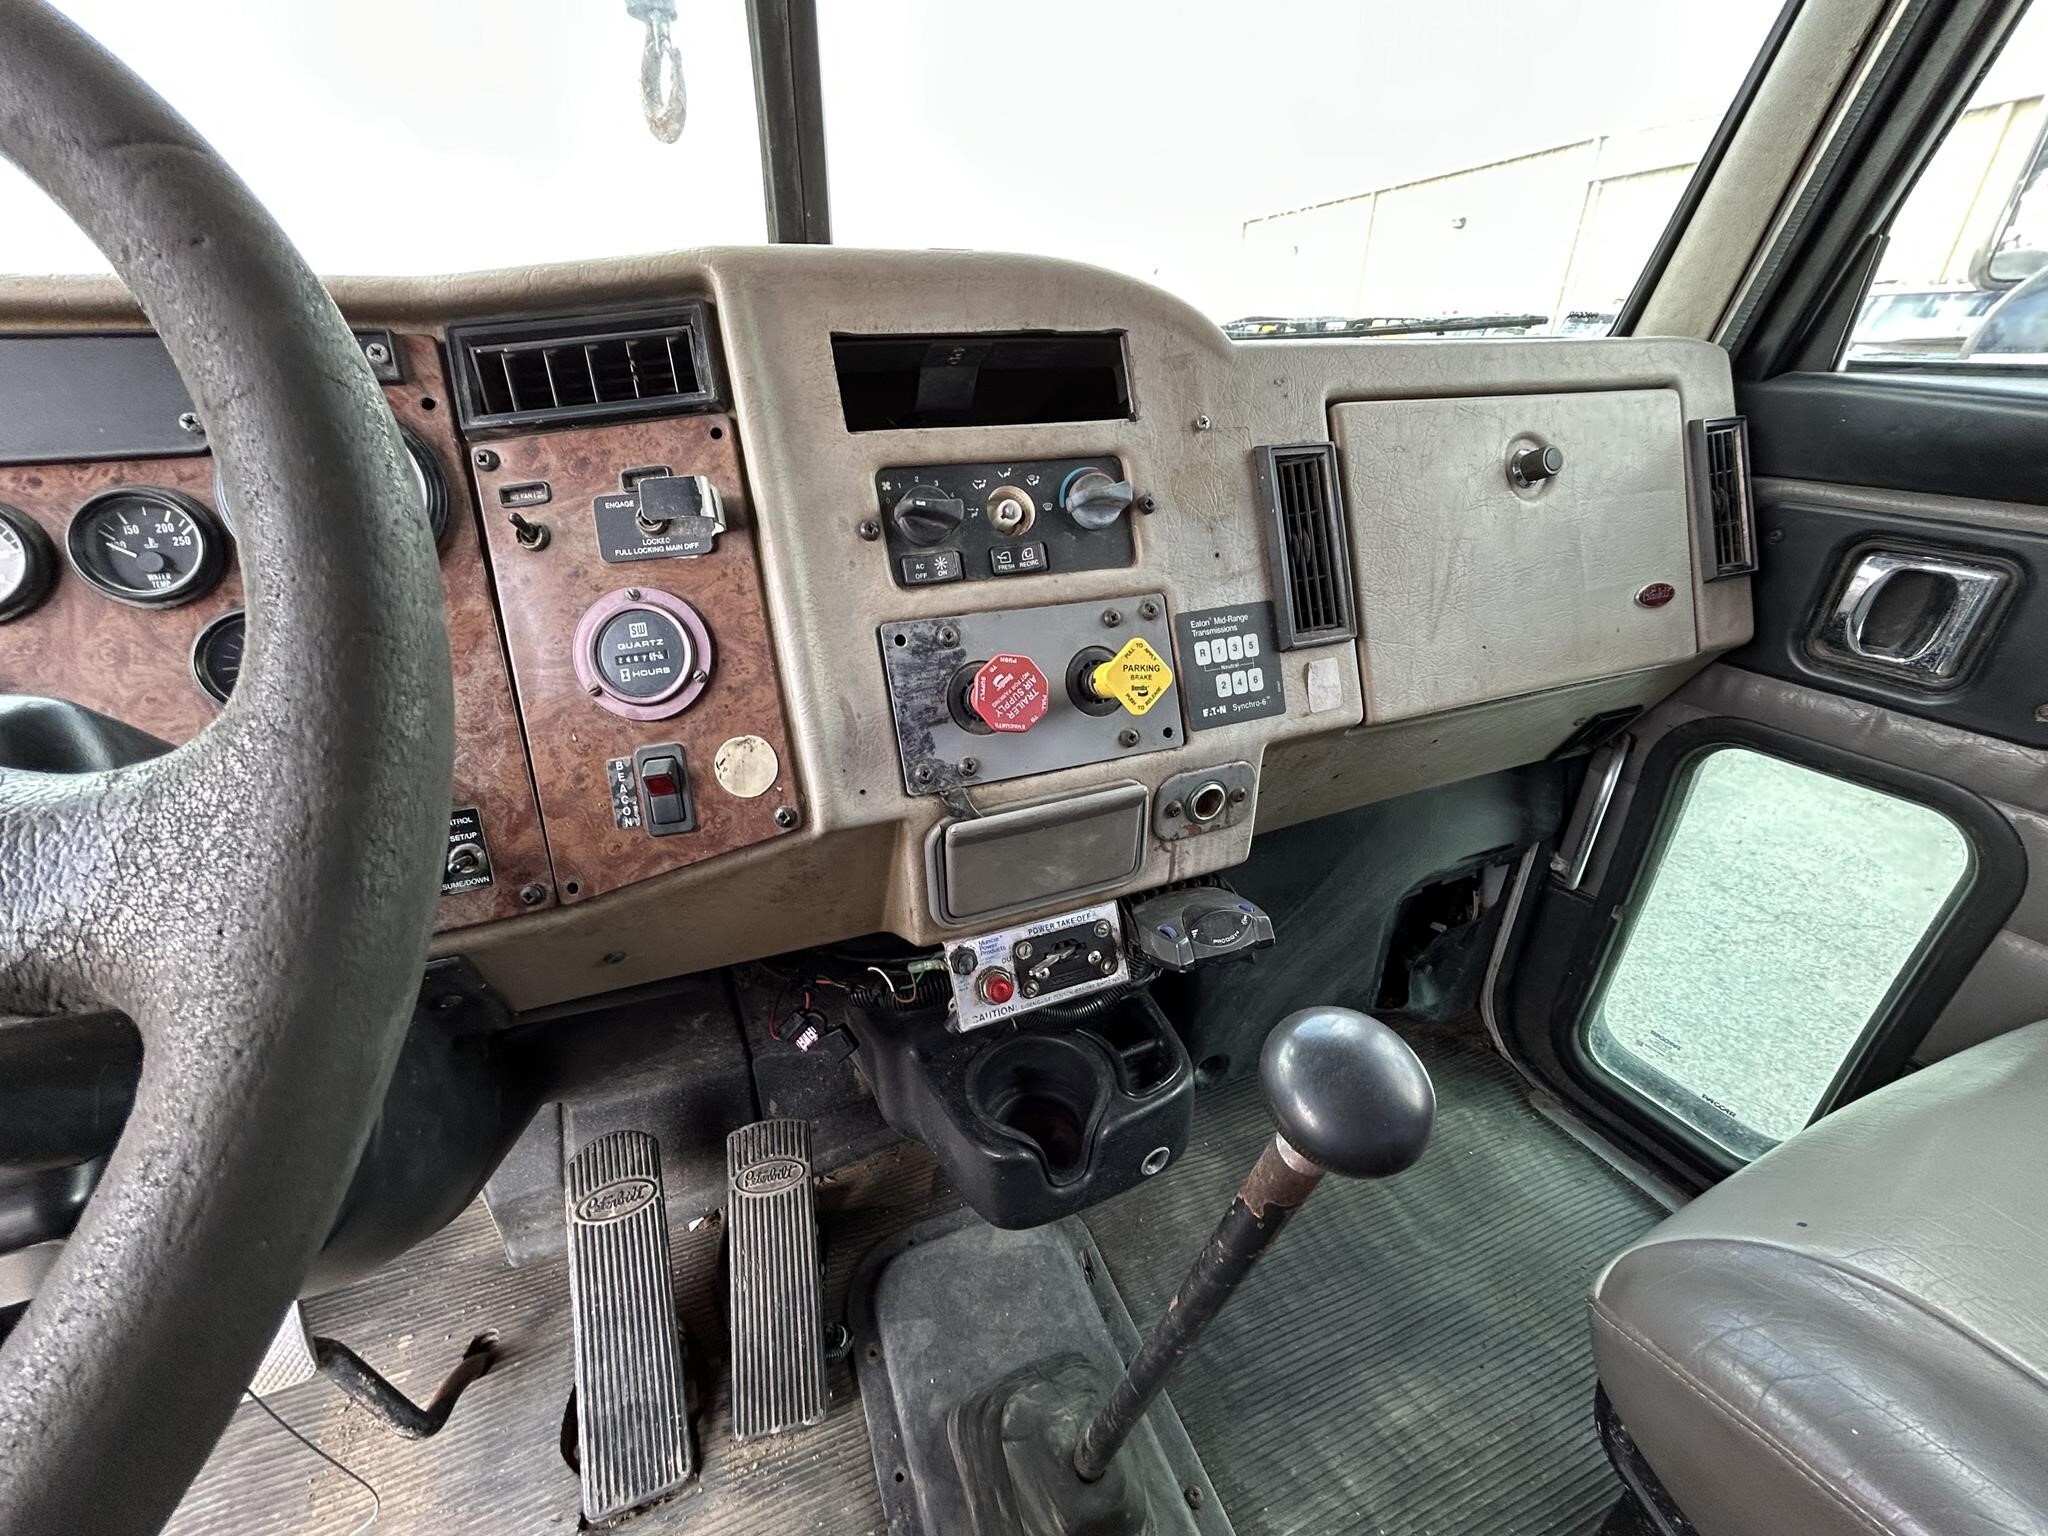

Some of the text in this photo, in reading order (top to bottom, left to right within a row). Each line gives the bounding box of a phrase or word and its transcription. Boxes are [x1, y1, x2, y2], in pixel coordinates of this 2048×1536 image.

[914, 475, 920, 483] 2
[934, 479, 940, 487] 3
[604, 500, 635, 510] ENGAGE
[123, 524, 140, 536] 150
[154, 522, 175, 534] 200
[172, 535, 192, 547] 250
[614, 541, 700, 557] FULL LOCKING MAIN DIFF
[997, 563, 1016, 571] FRESH
[1019, 559, 1040, 569] RECIRC
[914, 572, 928, 580] OFF
[937, 569, 948, 577] ON
[1213, 614, 1249, 625] Mid-Range
[1191, 624, 1238, 638] Transmissions
[617, 638, 665, 650] QUARTZ
[1199, 648, 1207, 657] R
[1232, 643, 1238, 652] 3
[1248, 641, 1254, 650] 5
[631, 666, 671, 678] HOURS
[1122, 664, 1160, 673] PARKING
[1221, 675, 1259, 690] 2 4 6
[995, 674, 1037, 718] AIR SUPPLY
[1006, 688, 1040, 720] TRAILER
[615, 761, 633, 828] BEACON
[449, 816, 474, 827] TROL
[442, 876, 490, 891] SUME/DOWN
[1027, 922, 1055, 935] POWER
[1001, 956, 1012, 964] OU
[744, 1164, 799, 1190] Peterbilt
[586, 1183, 650, 1218] Peterbilt
